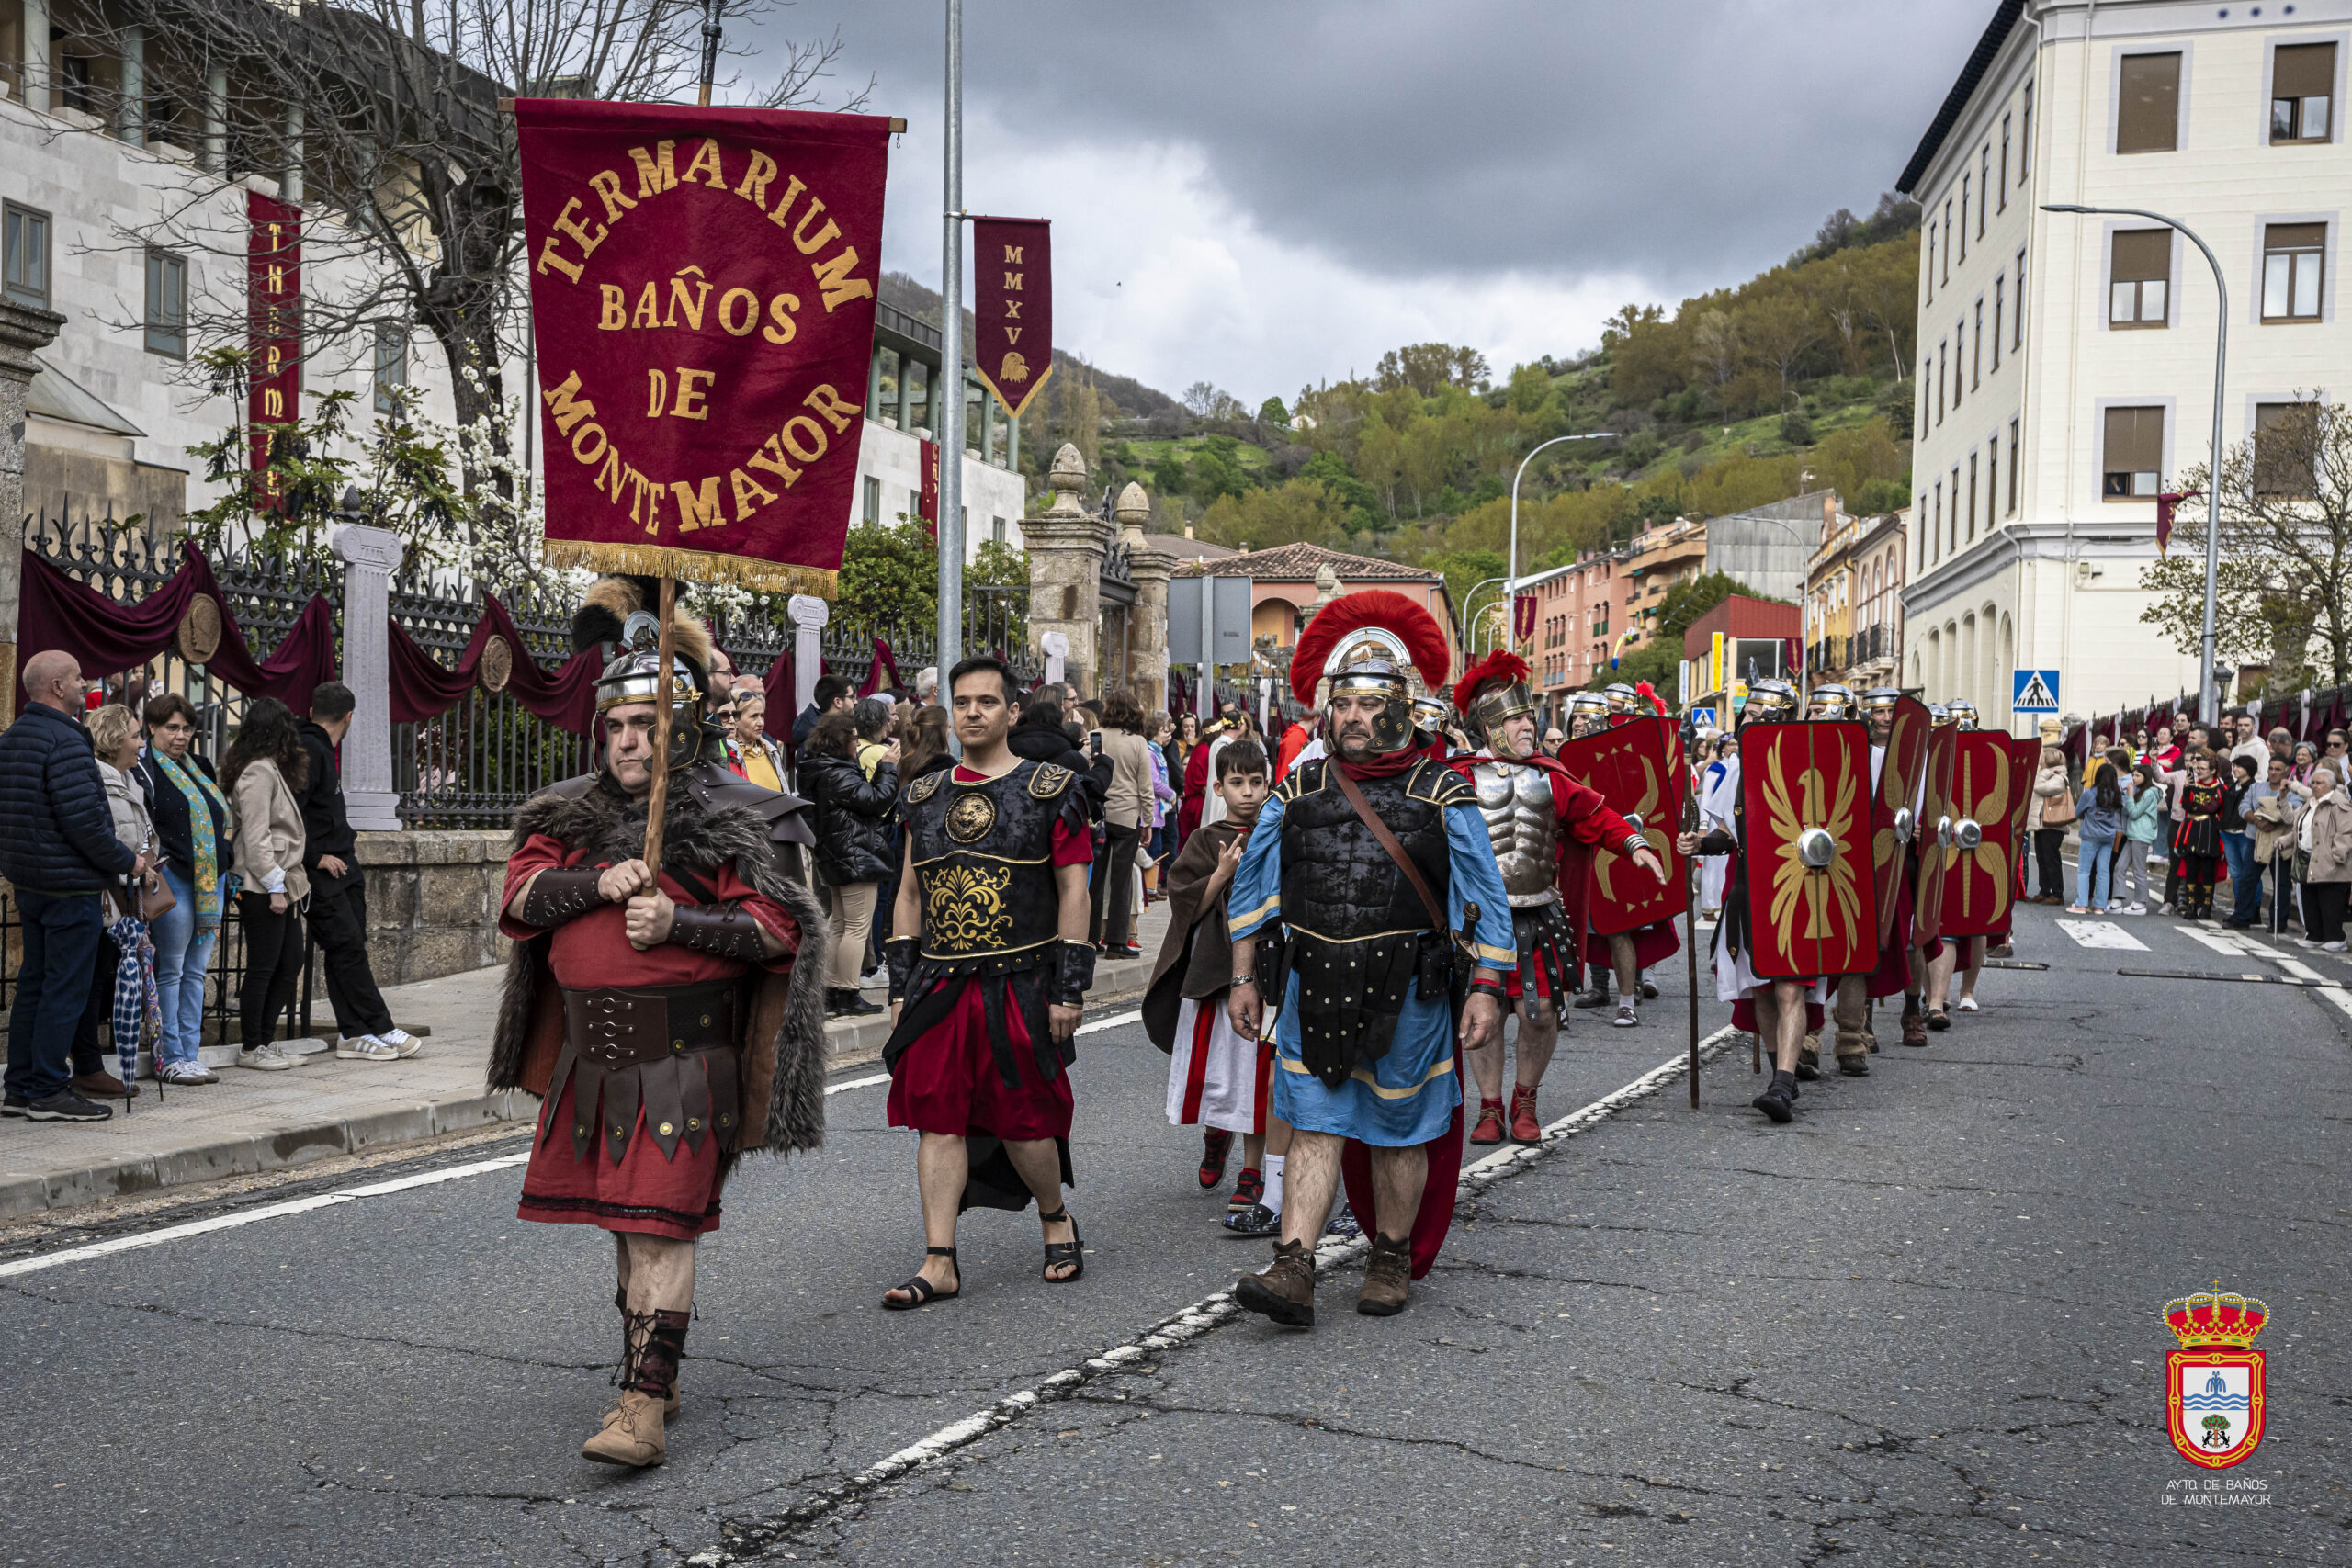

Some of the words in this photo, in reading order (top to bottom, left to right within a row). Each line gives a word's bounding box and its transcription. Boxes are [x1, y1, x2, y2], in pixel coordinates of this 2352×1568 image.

[538, 139, 873, 312] TERMARIUM
[597, 265, 801, 344] BAÑOS
[1003, 244, 1023, 345] MMXV
[647, 367, 716, 421] DE
